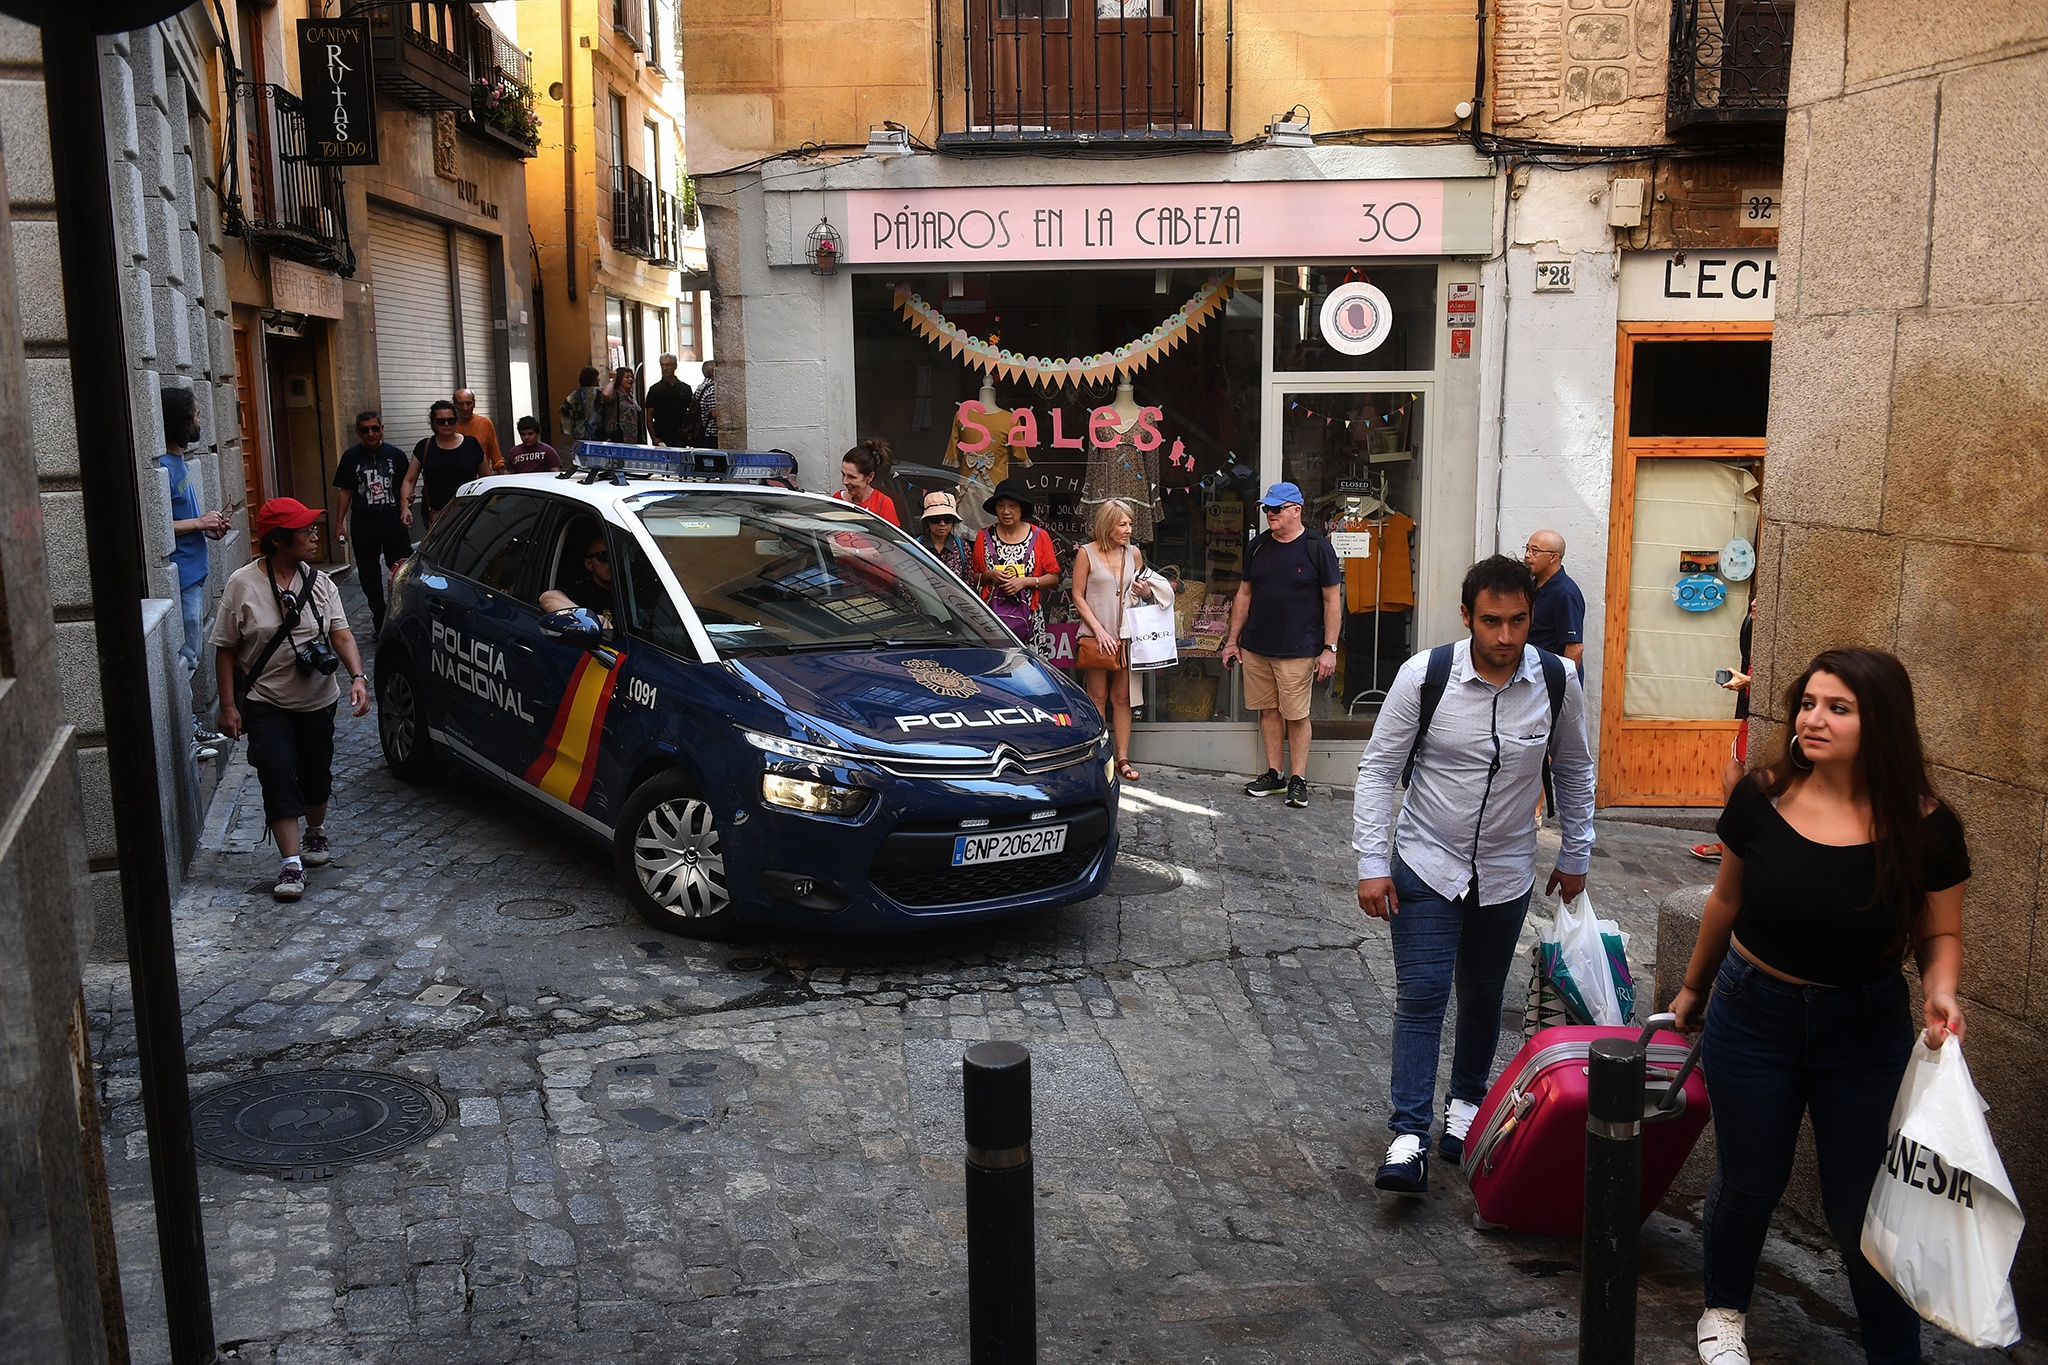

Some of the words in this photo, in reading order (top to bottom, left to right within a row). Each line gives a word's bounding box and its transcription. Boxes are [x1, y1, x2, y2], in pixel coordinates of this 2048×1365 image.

[318, 141, 366, 157] TOLEDO
[1748, 196, 1774, 220] 32
[873, 204, 1011, 250] PÁJAROS
[1033, 208, 1063, 247] EN
[1085, 207, 1113, 246] LA
[1135, 205, 1240, 246] CABEZA
[1358, 202, 1422, 243] 30
[1548, 265, 1571, 286] 28
[1026, 474, 1105, 499] LOTHES
[1340, 481, 1369, 489] CLOSED
[431, 619, 508, 681] POLICÍA
[431, 648, 535, 724] NACIONAL
[894, 705, 1057, 733] POLICÍA
